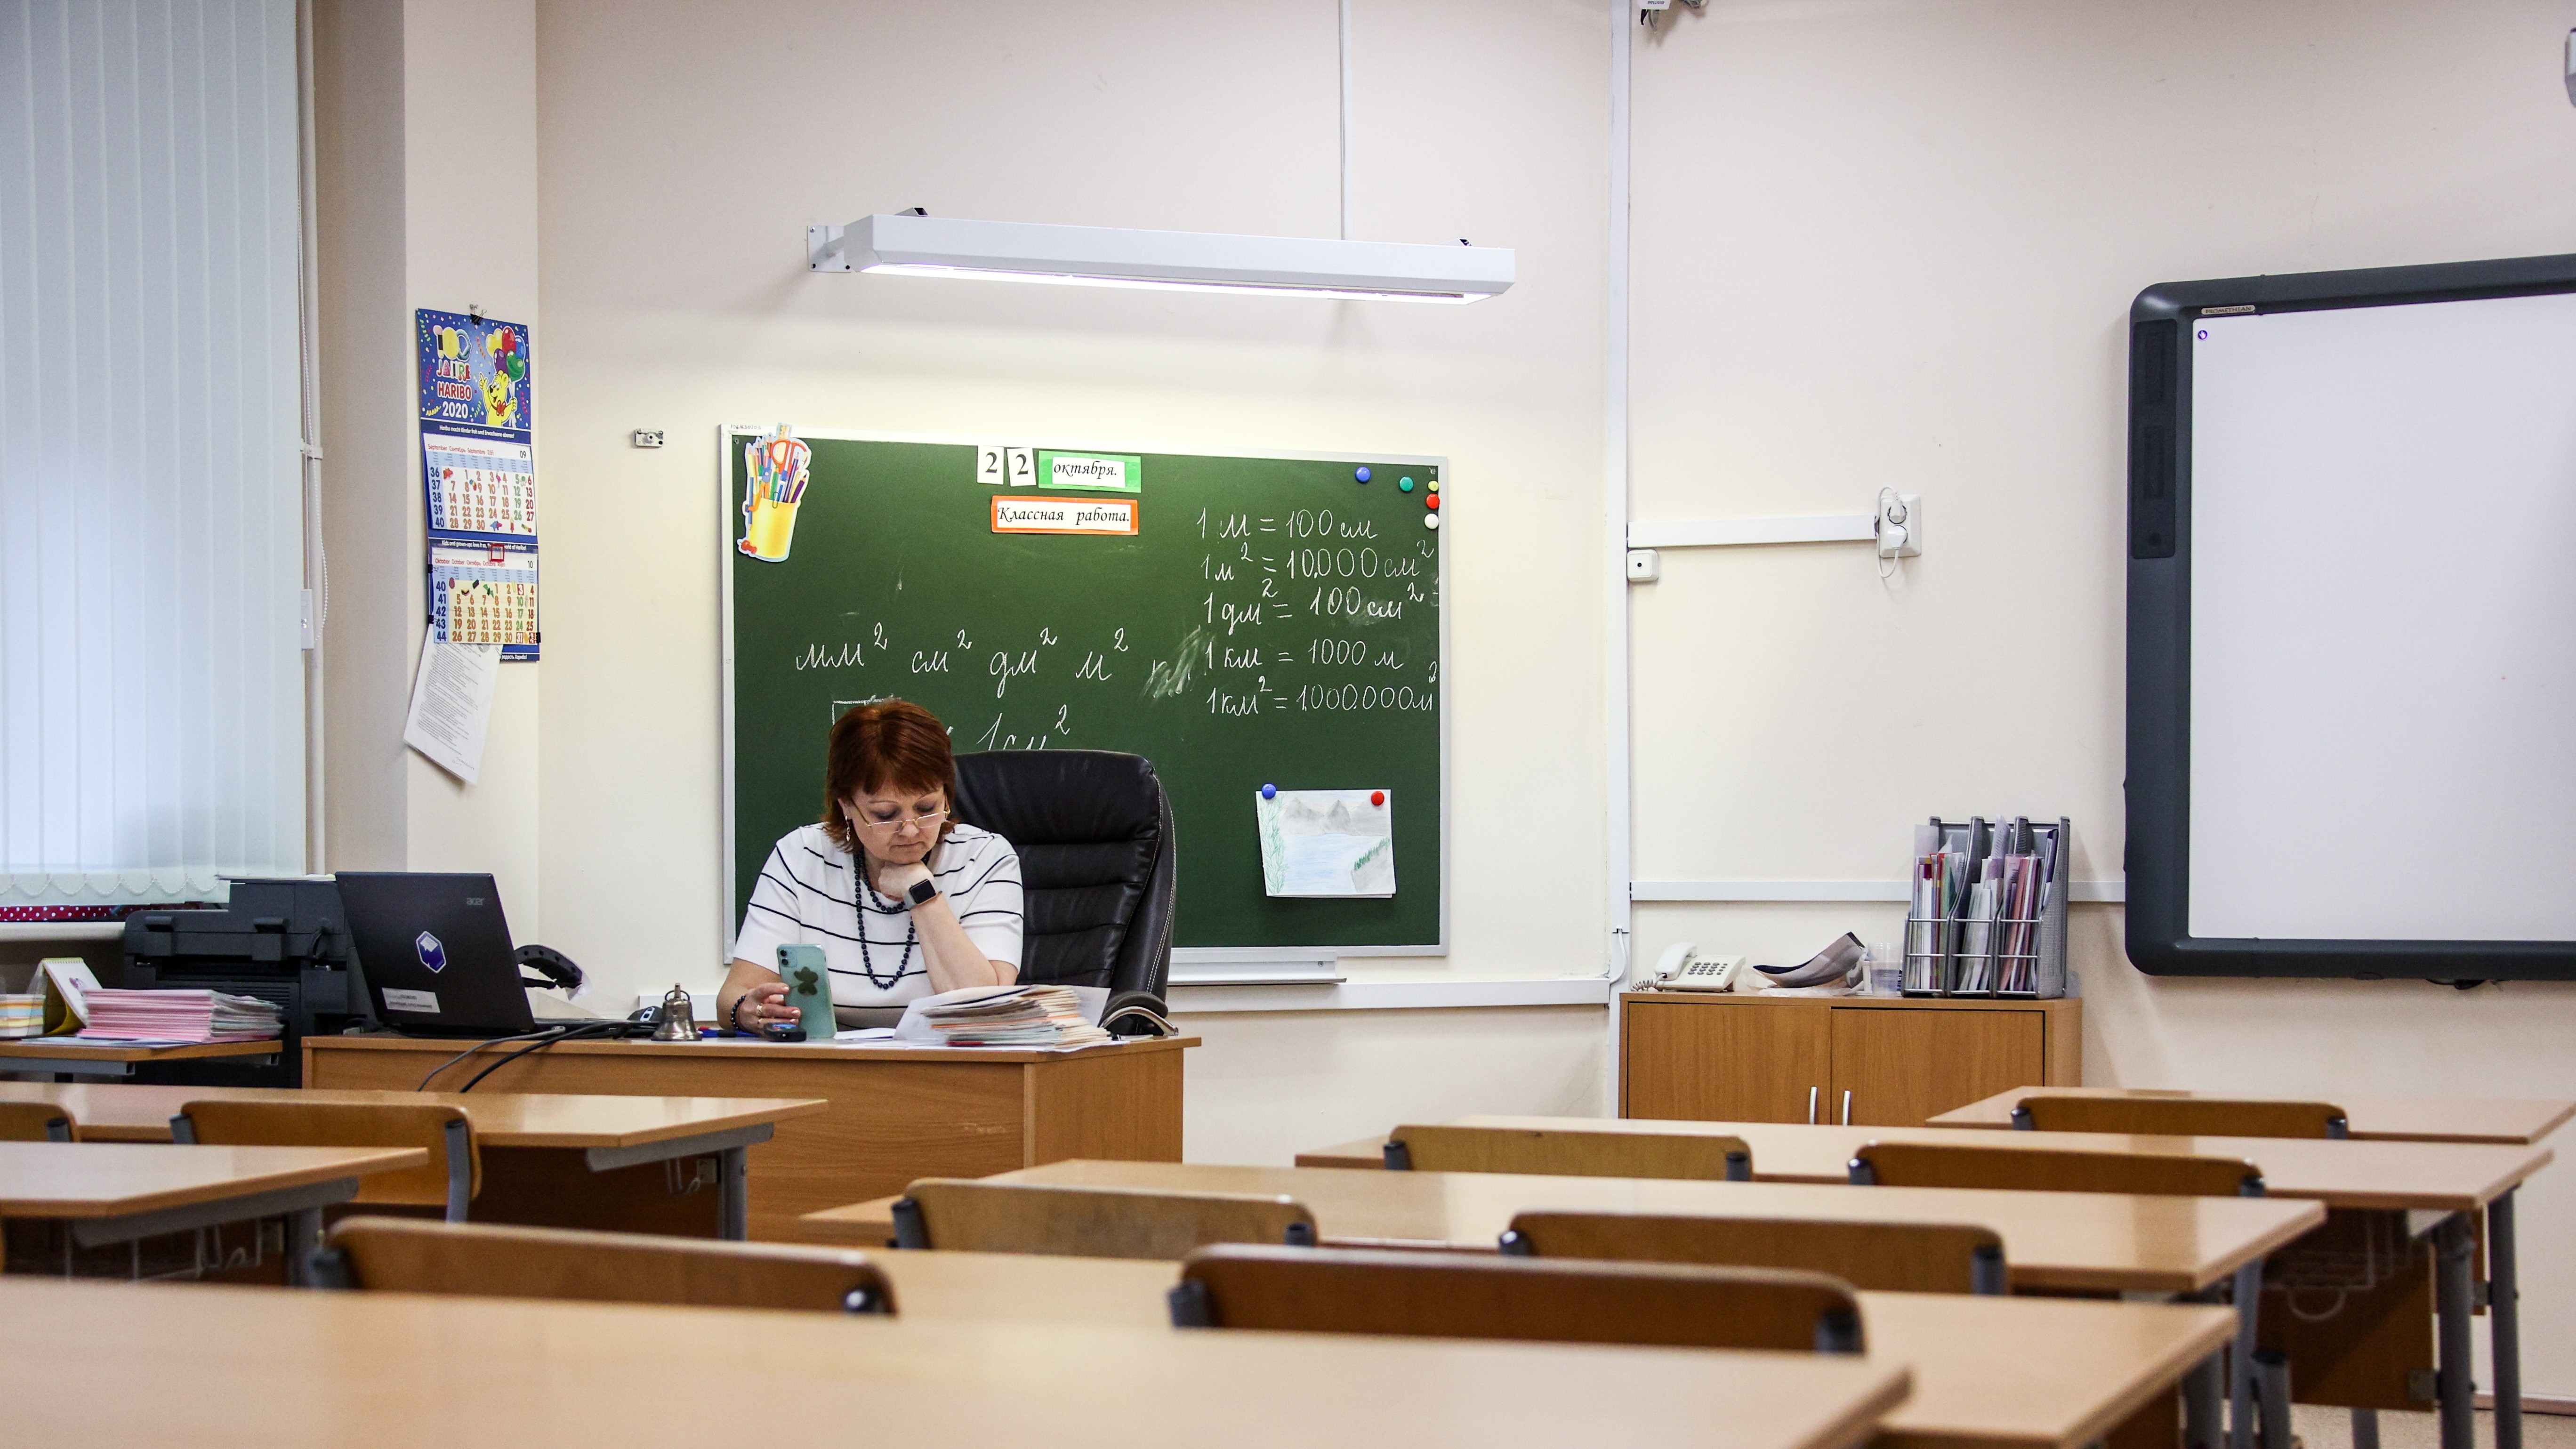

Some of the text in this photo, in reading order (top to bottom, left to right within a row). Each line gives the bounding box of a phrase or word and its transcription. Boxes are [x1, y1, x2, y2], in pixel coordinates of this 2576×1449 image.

[433, 325, 472, 362] 100
[437, 381, 471, 401] HARIBO
[443, 401, 468, 419] 2020
[430, 467, 531, 485] 36 1 2 3 4 5 6
[1054, 461, 1117, 479] октября.
[432, 480, 532, 497] 37 7 8 9 10 11 12 13
[433, 492, 533, 509] 38 14 15 16 17 18 19 20
[434, 505, 534, 521] 39 21 22 23 24 25 26 27
[998, 507, 1129, 525] Классная работа.
[435, 517, 485, 530] 40 28 29 30
[436, 581, 534, 595] 40 1 2 3 4
[438, 594, 533, 607] 41 5 6 7 8 9 10 11
[436, 606, 533, 619] 42 12 13 14 15 16 17 18
[436, 619, 533, 631] 43 19 20 21 22 23 24 25
[437, 631, 446, 641] 44
[452, 631, 462, 642] 26
[467, 631, 476, 642] 27
[481, 632, 489, 642] 28
[493, 632, 501, 642] 29
[505, 632, 512, 643] 30
[516, 632, 523, 643] 31
